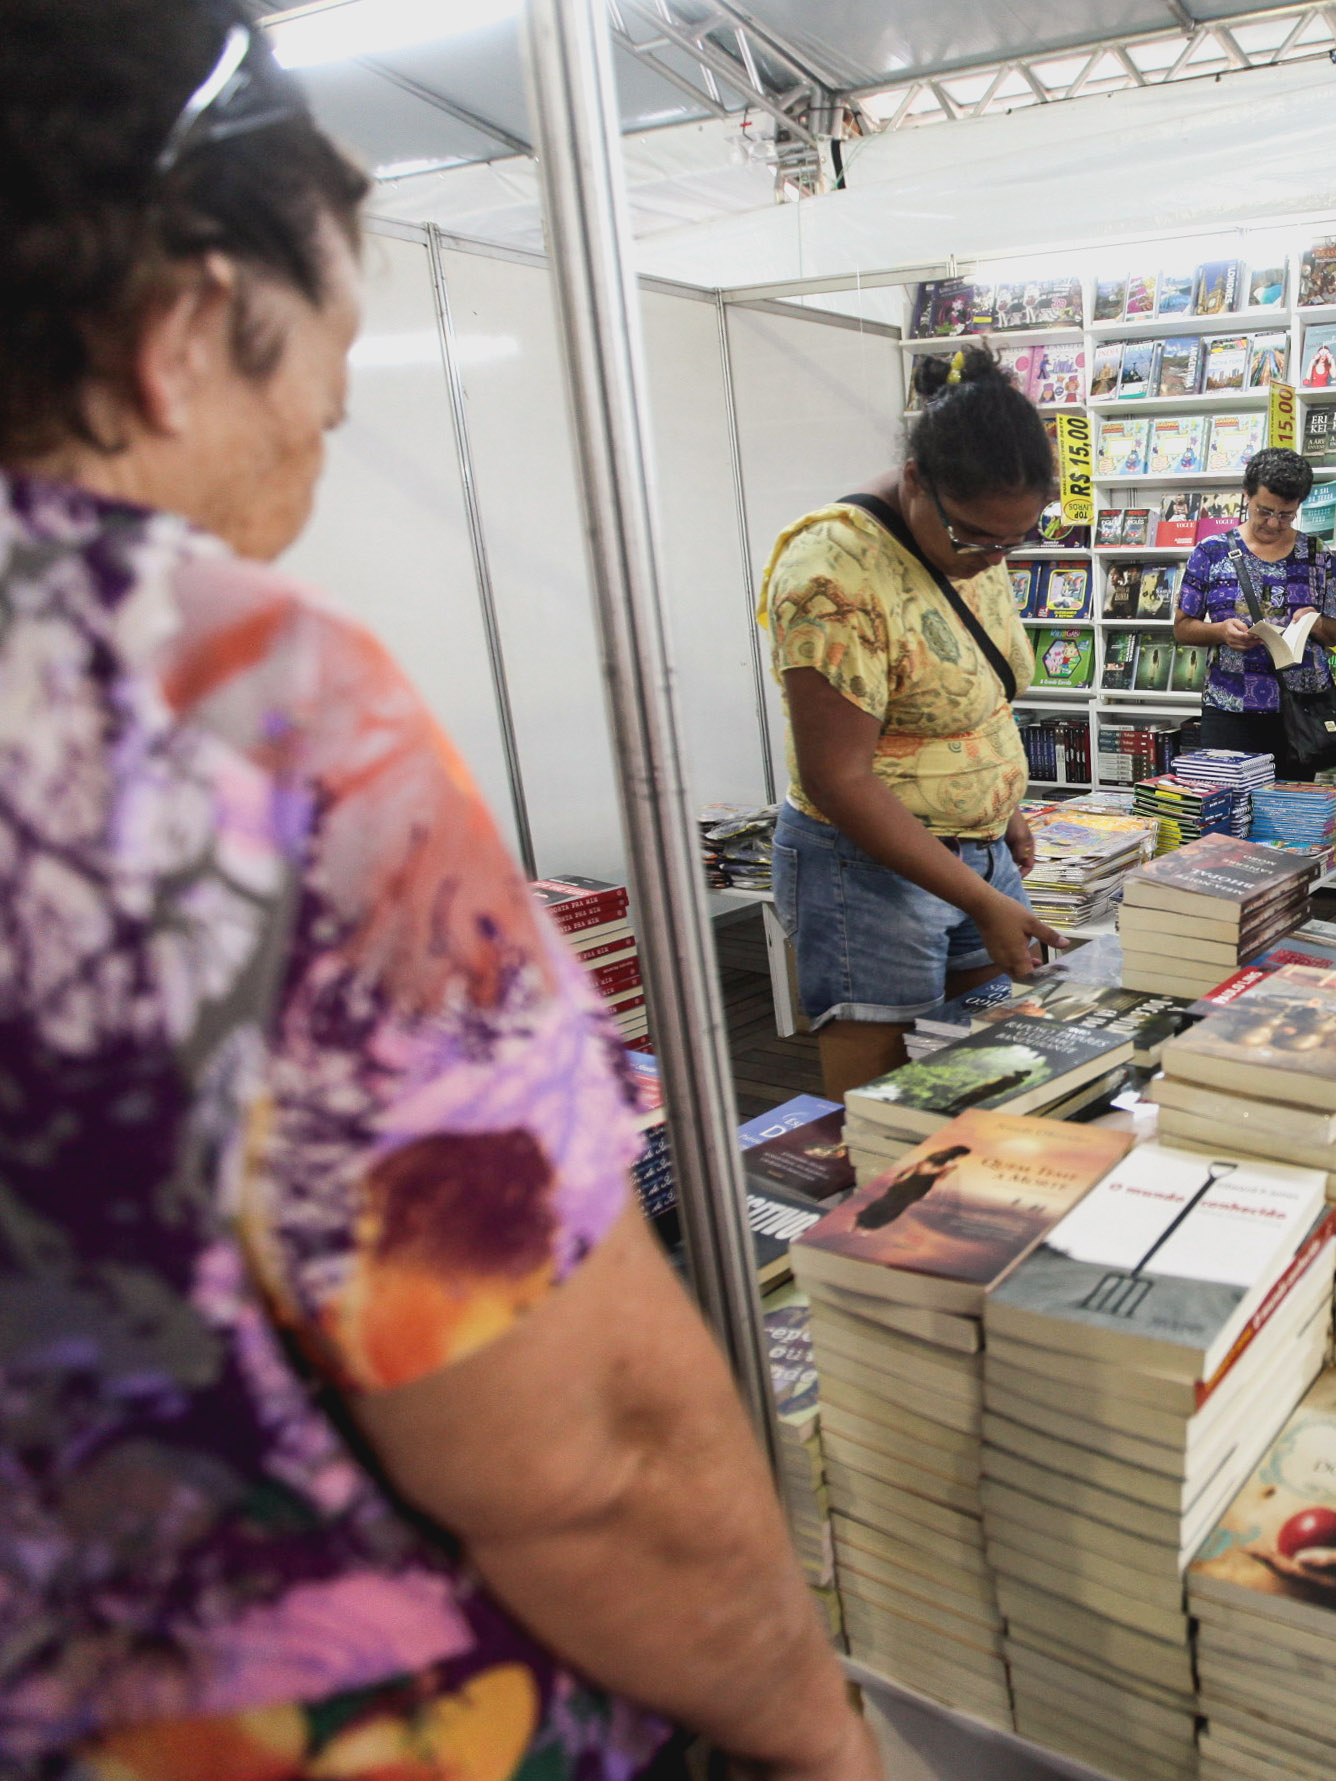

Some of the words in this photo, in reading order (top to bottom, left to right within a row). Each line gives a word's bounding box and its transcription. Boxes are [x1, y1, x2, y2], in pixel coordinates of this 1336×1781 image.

[1224, 261, 1236, 305] LONDRES
[1279, 388, 1293, 443] 15,00
[1312, 415, 1327, 424] ERI
[1068, 417, 1091, 466] 15,00
[1070, 473, 1090, 497] R$
[1074, 511, 1088, 519] TOP
[1191, 868, 1256, 889] BHOPAL
[1125, 1186, 1185, 1203] mundo
[1200, 1197, 1288, 1220] conhecido
